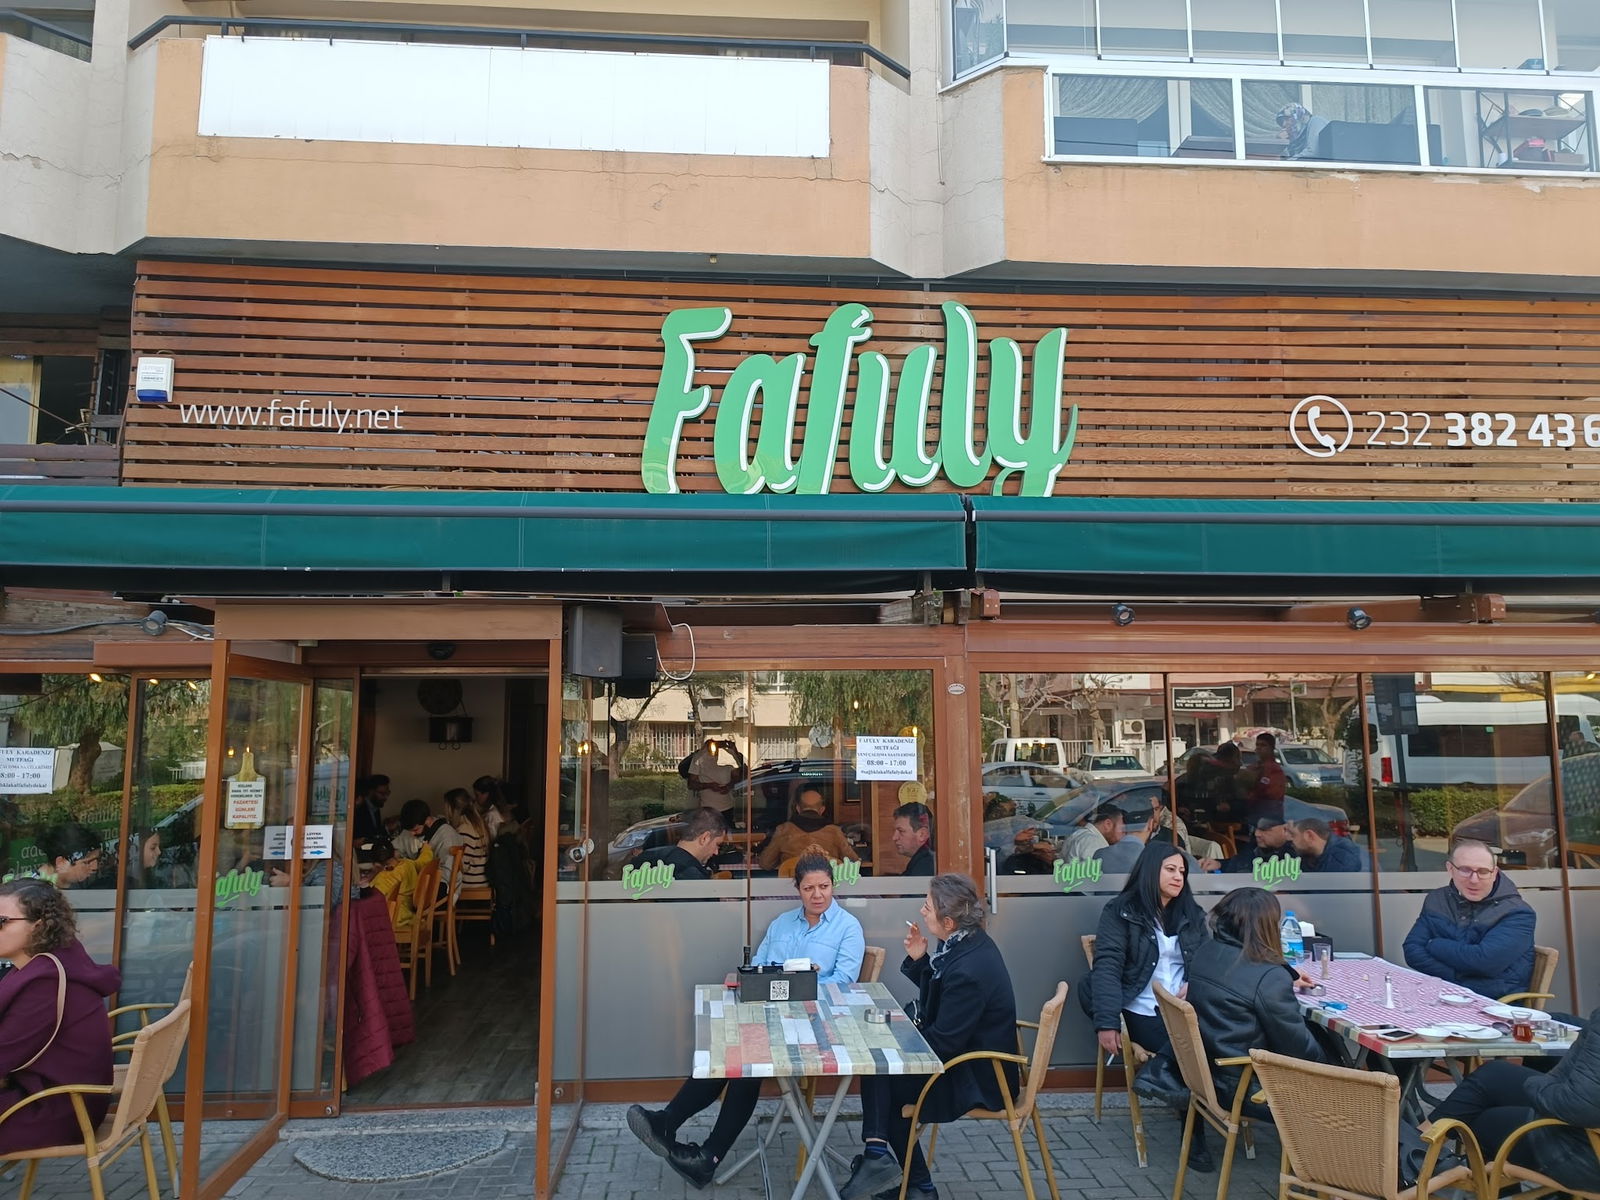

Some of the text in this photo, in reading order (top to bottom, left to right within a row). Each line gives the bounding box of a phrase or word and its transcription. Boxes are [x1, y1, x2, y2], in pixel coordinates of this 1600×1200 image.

[180, 399, 404, 434] www.fafuly.net
[641, 301, 1078, 497] Fafuly
[1367, 411, 1432, 446] 232
[1444, 412, 1518, 447] 382
[1528, 413, 1576, 448] 43
[215, 866, 264, 904] afuly
[622, 859, 676, 897] Fafuly
[1053, 856, 1103, 892] Fafuly
[1253, 853, 1302, 891] Fafuly
